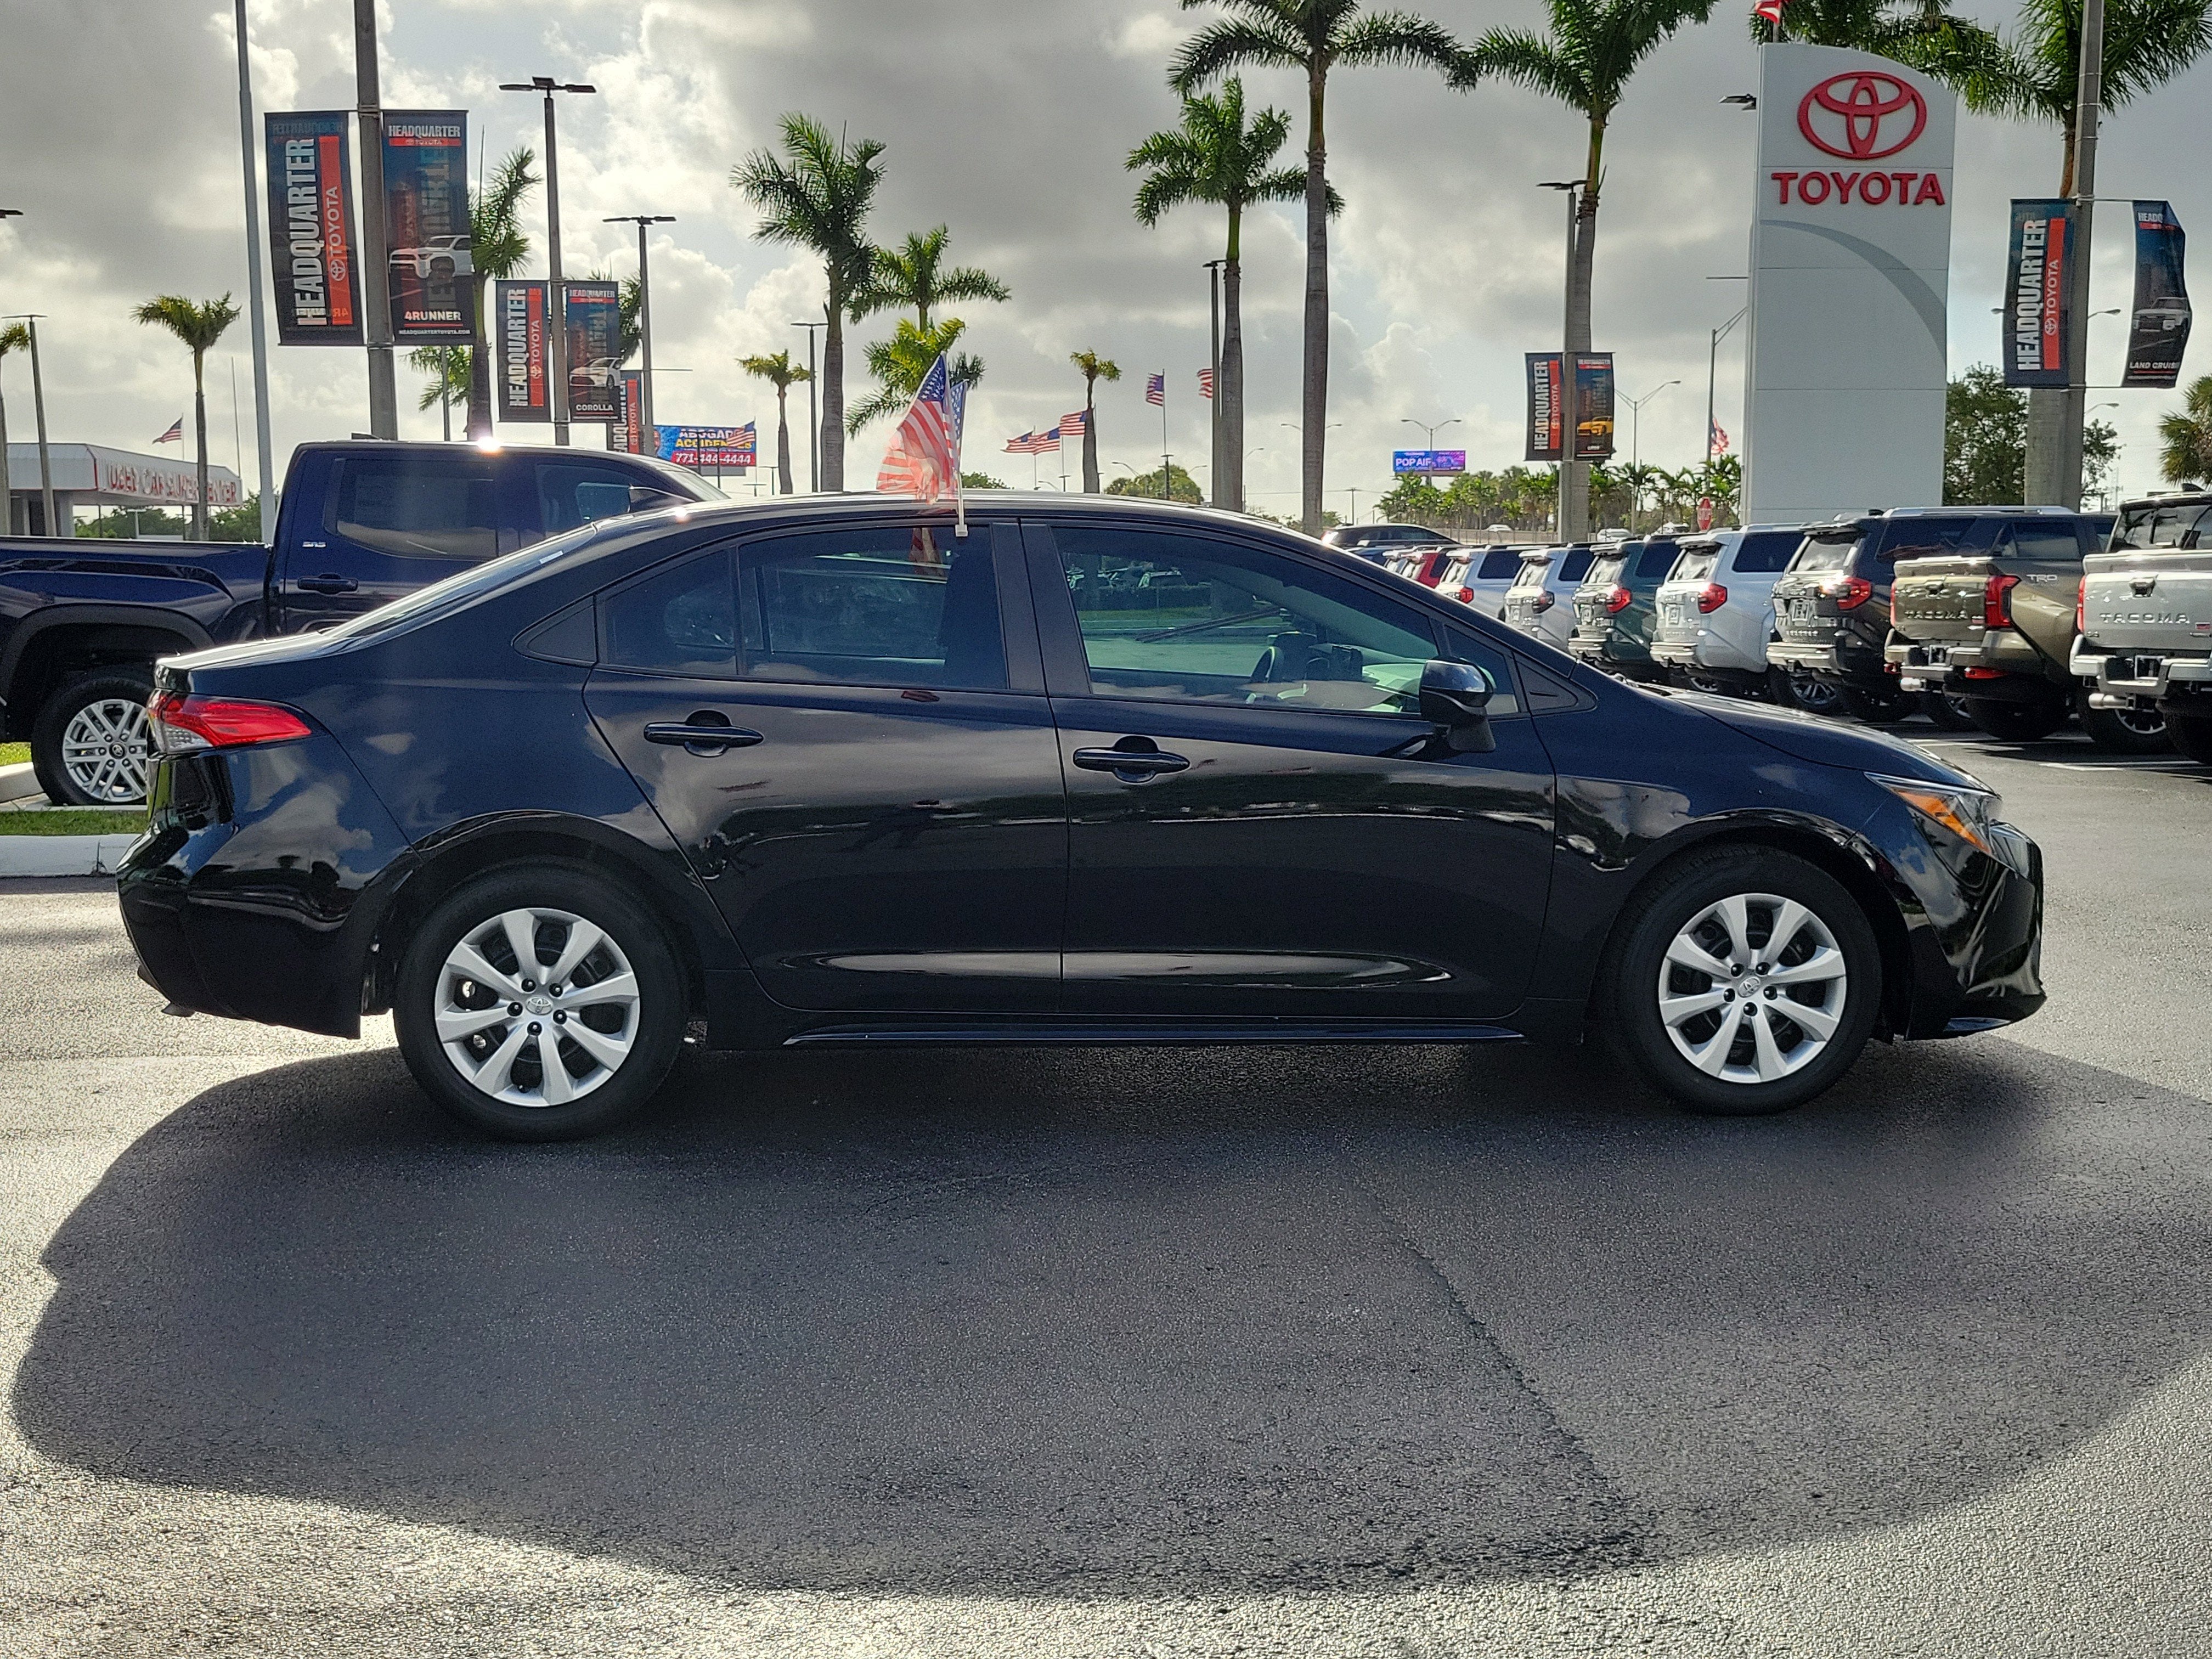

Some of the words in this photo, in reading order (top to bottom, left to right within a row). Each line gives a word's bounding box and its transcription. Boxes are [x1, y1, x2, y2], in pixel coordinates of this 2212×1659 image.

[388, 125, 461, 138] HEADQUARTER
[1771, 171, 1945, 206] TOYOTA
[285, 138, 328, 325] HEADQUARTER
[328, 185, 346, 258] TOYOTA
[2016, 219, 2046, 371] HEADQUARTER
[2046, 259, 2059, 315] TOYOTA
[404, 311, 462, 320] 4RUNNER
[507, 288, 529, 407] HEADQUARTER
[531, 320, 541, 366] TOYOTA
[1534, 361, 1551, 450] HEADQUARTER
[1551, 385, 1560, 419] TOYOTA
[1396, 458, 1415, 466] POP
[1905, 610, 1968, 619] TACOMA
[2100, 613, 2190, 623] TACOMA
